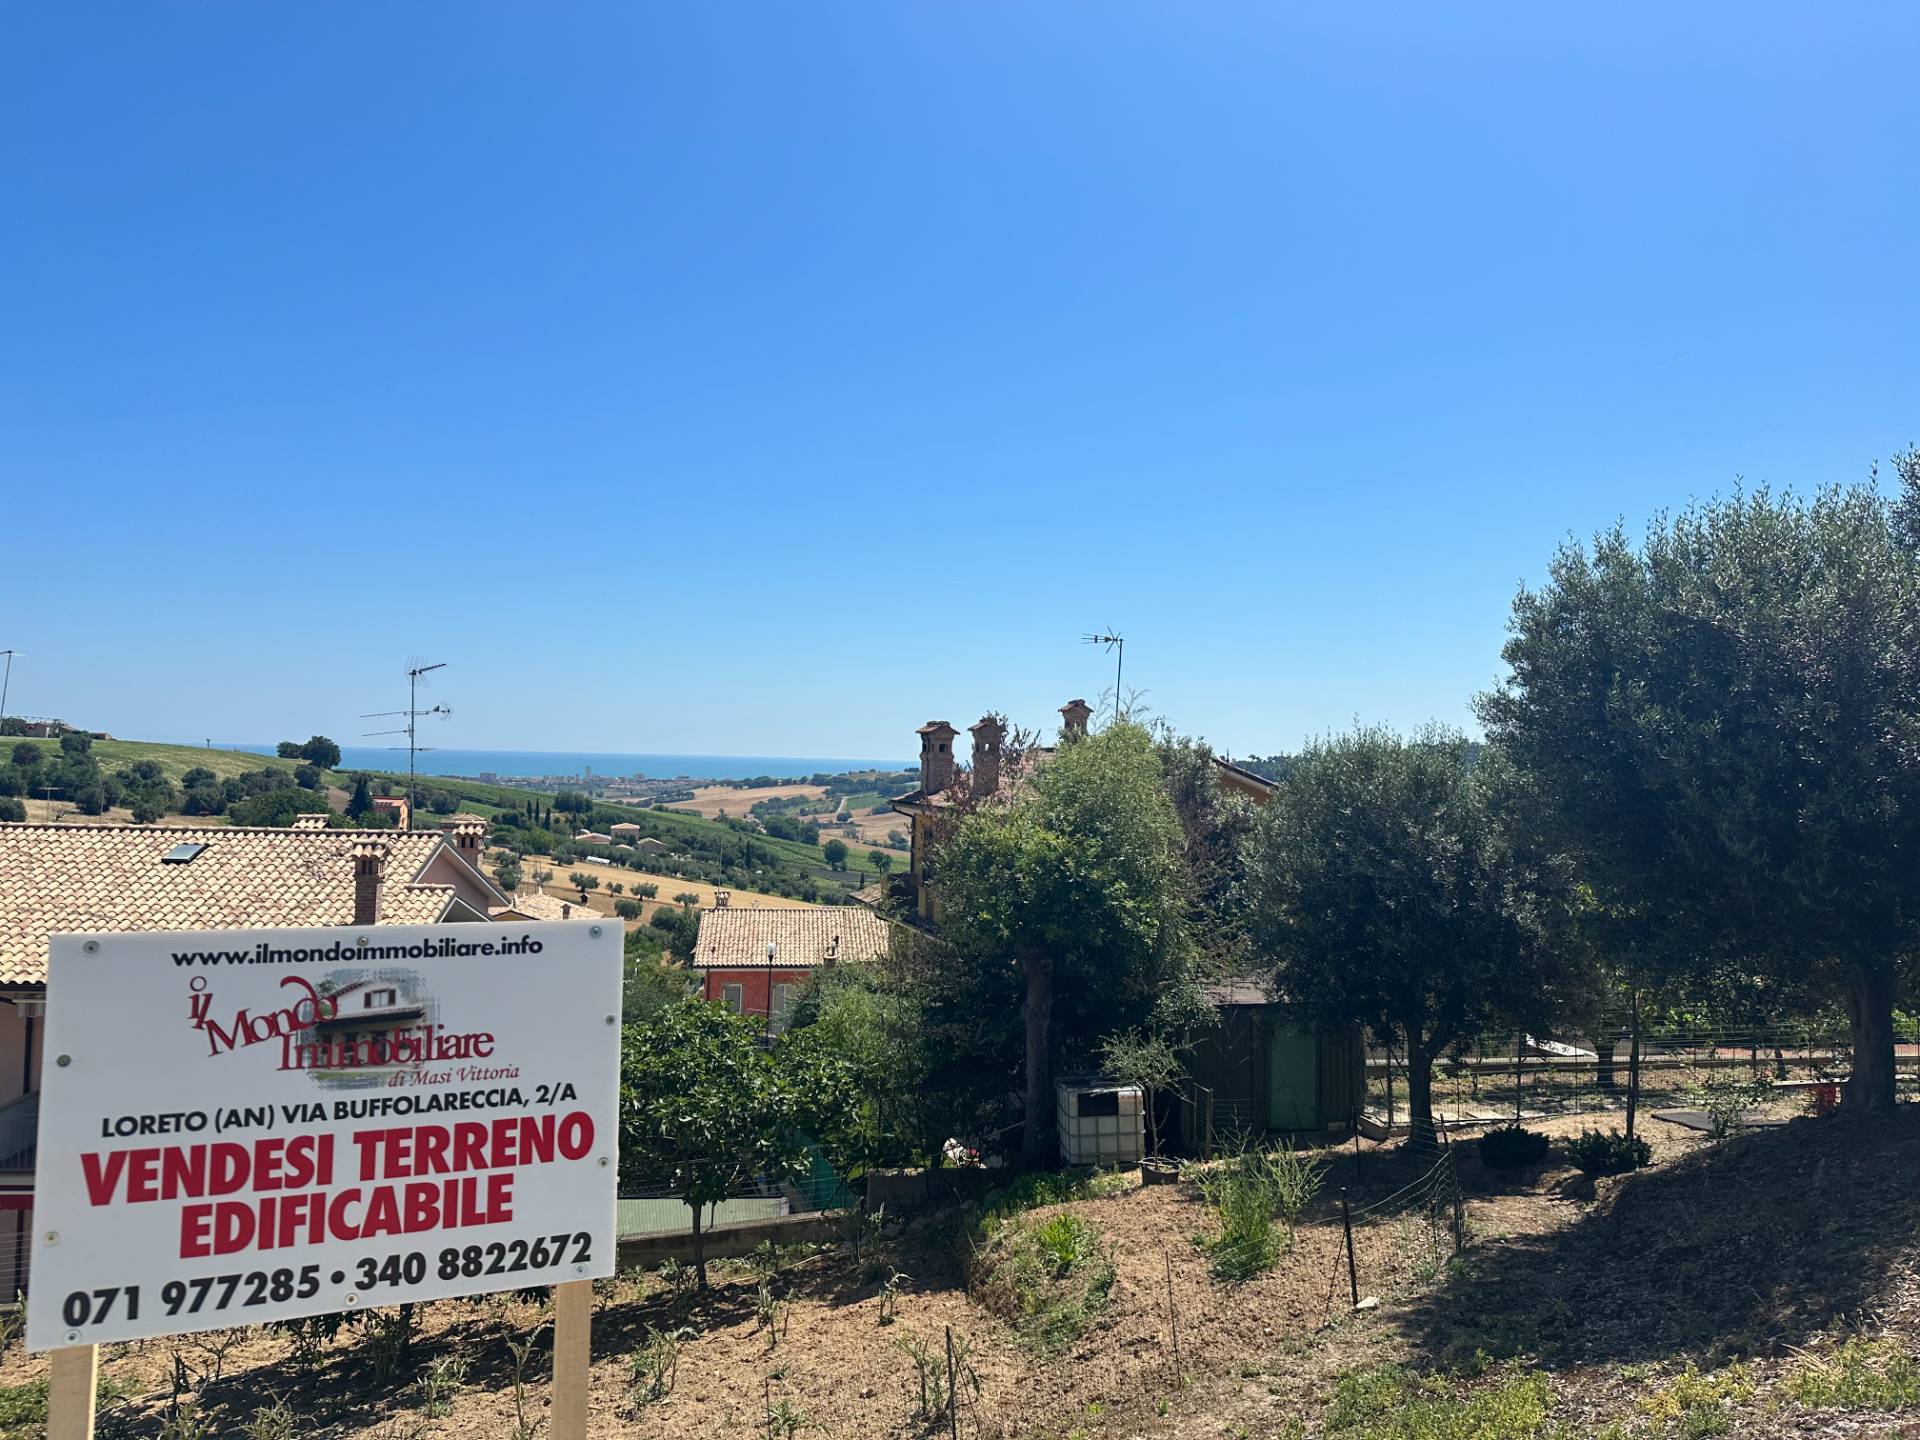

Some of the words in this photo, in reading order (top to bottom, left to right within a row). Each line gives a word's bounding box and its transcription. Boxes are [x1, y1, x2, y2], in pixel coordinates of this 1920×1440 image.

[172, 936, 543, 967] www.ilmondoimmobiliare.info
[187, 975, 213, 1030] il
[205, 975, 339, 1057] Mondo
[276, 1025, 494, 1072] Immobiliare
[102, 1111, 207, 1138] LORETO
[214, 1105, 274, 1134] (AN)
[282, 1103, 328, 1124] VIA
[334, 1087, 530, 1121] BUFFOLARECCIA,
[535, 1082, 576, 1105] 2/A
[388, 1071, 406, 1088] di
[410, 1067, 452, 1086] Masi
[456, 1064, 520, 1082] Vittoria
[81, 1133, 333, 1206] VENDESI
[353, 1111, 594, 1182] TERRENO
[180, 1174, 514, 1259] EDIFICABILE
[63, 1285, 139, 1327] 071
[161, 1264, 320, 1316] 977285
[355, 1252, 426, 1291] 340
[437, 1232, 592, 1282] 8822672
